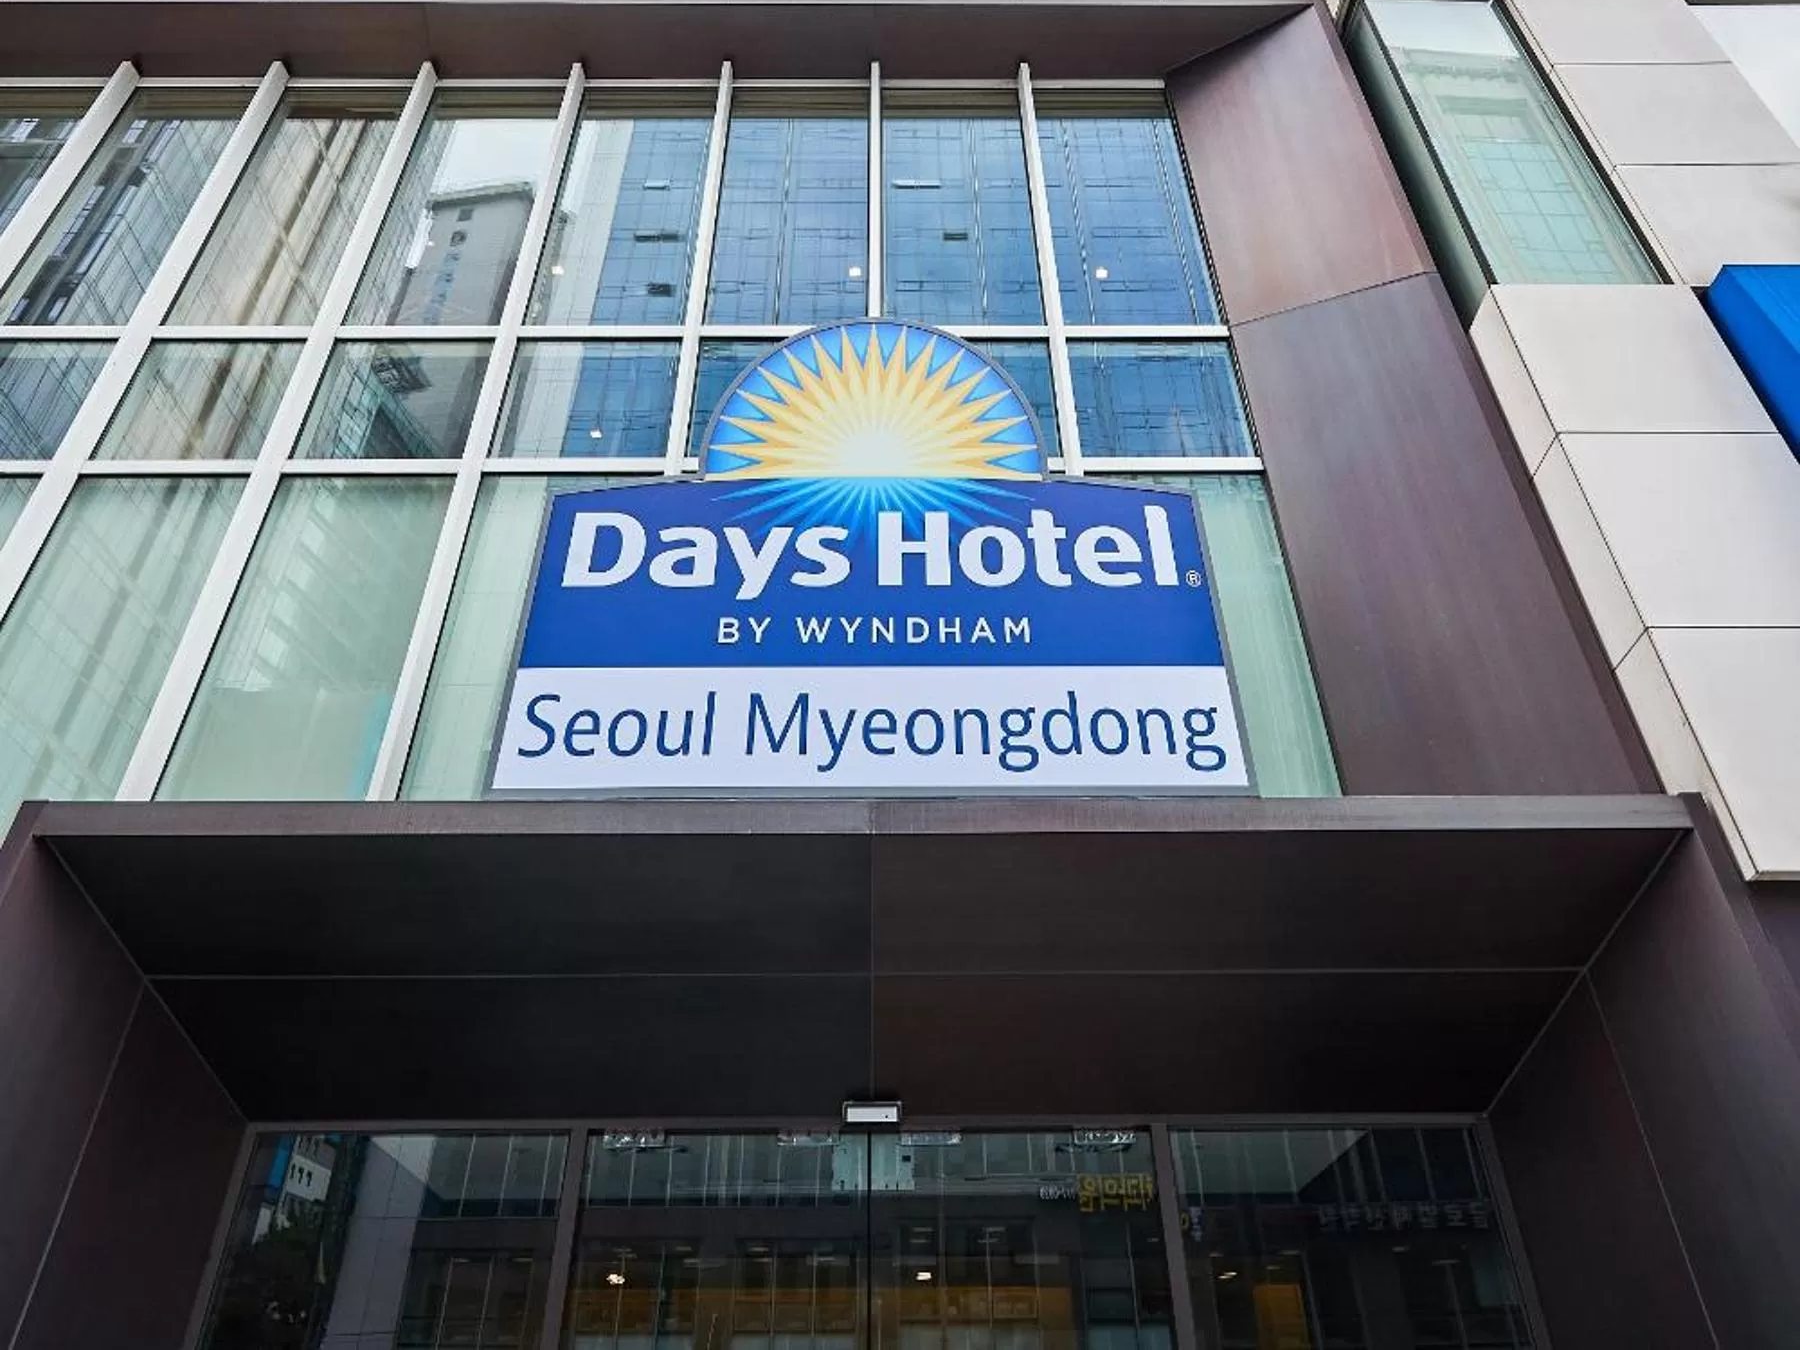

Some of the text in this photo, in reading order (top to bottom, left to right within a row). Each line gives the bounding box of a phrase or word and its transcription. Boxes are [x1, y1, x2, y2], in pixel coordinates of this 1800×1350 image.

[561, 512, 850, 600] Days
[717, 617, 1031, 643] BY WYNDHAM
[518, 691, 1227, 772] Seoul Myeongdong
